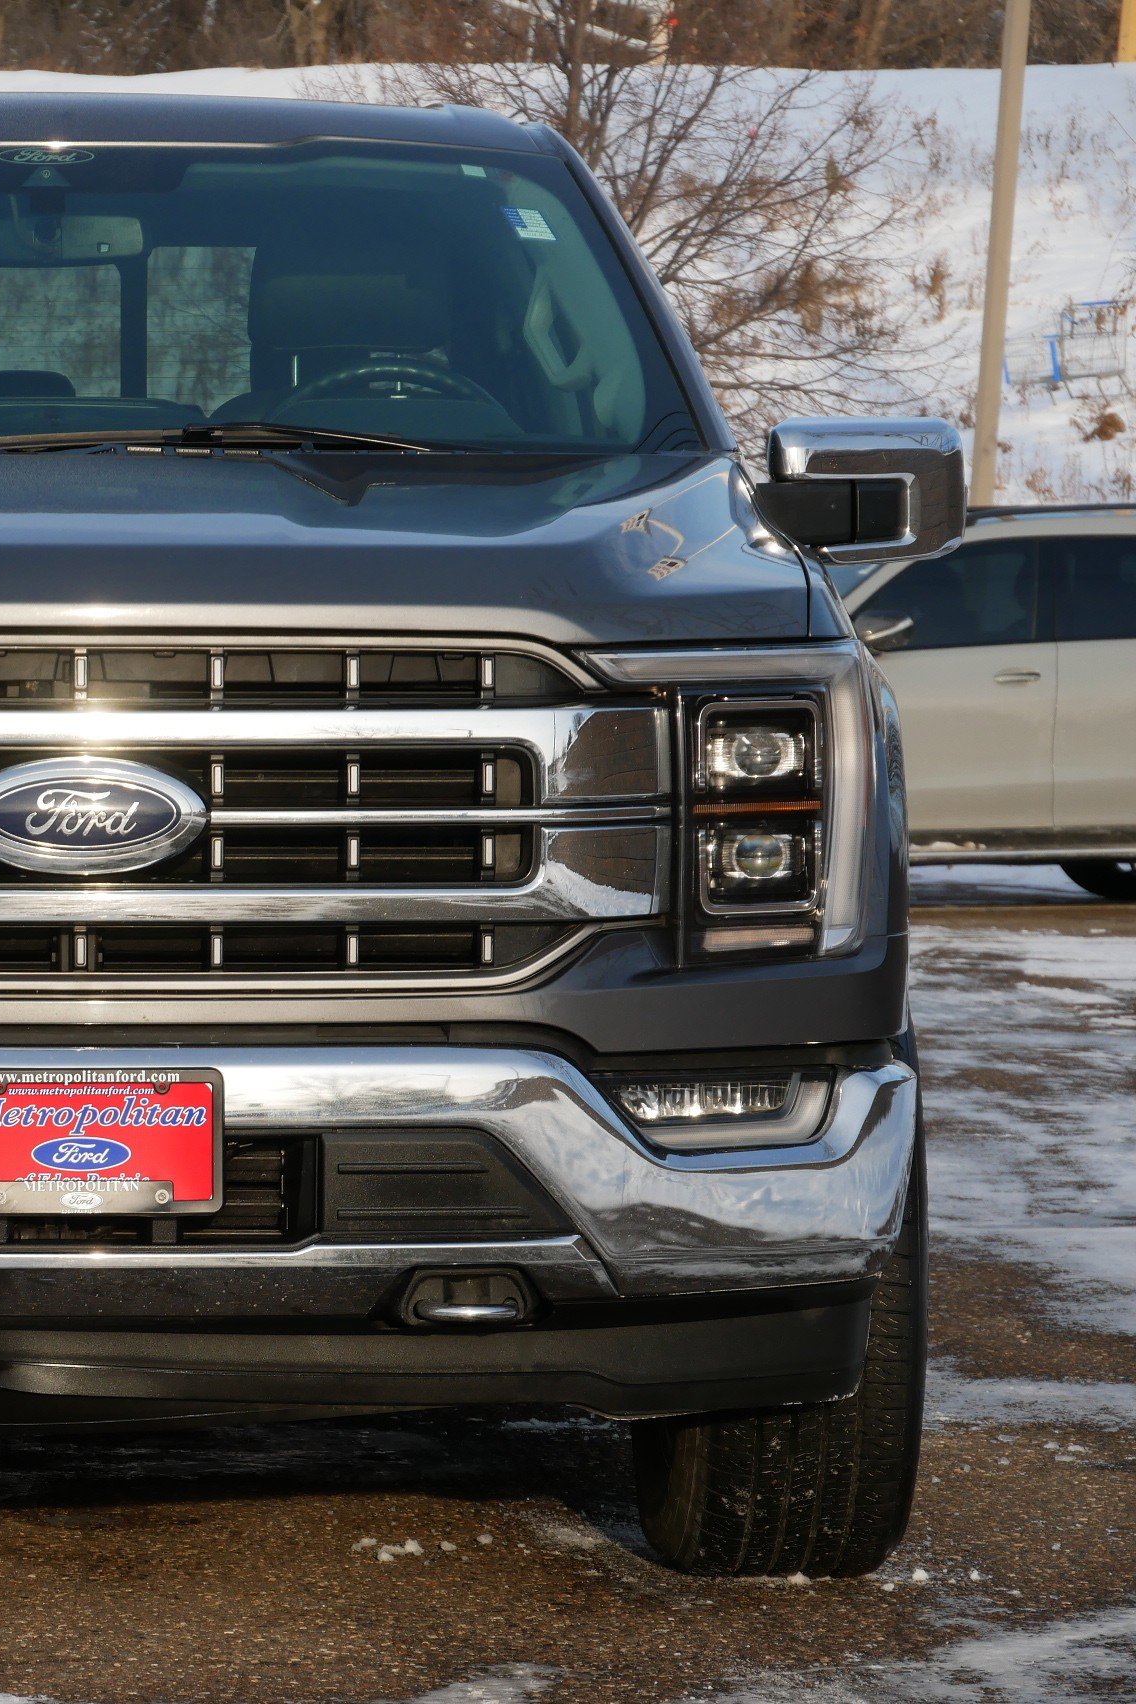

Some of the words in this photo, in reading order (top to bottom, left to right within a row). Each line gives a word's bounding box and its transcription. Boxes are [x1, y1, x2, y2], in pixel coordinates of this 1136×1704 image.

[14, 148, 77, 161] Ford
[25, 788, 140, 836] Ford
[8, 1085, 155, 1097] www.metropolitanford.com
[52, 1142, 109, 1165] Ford
[24, 1180, 140, 1192] METROPOLITAN
[68, 1195, 94, 1205] Ford
